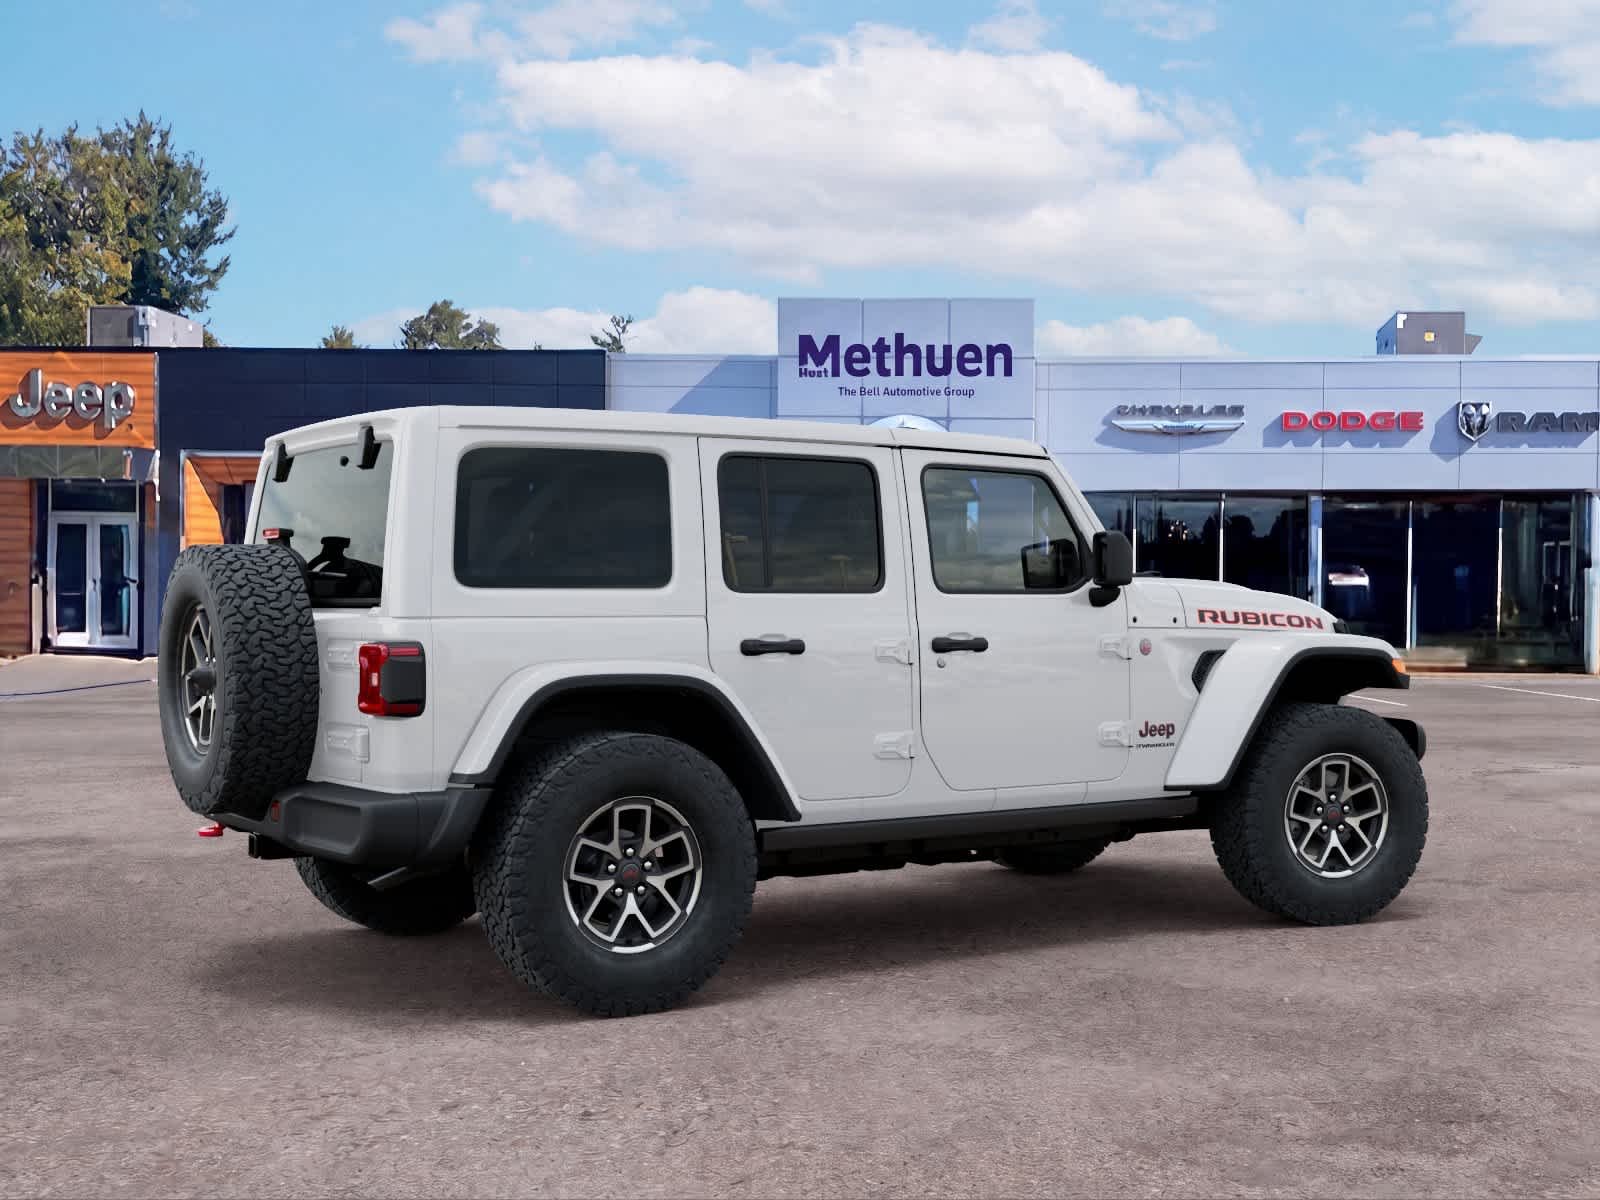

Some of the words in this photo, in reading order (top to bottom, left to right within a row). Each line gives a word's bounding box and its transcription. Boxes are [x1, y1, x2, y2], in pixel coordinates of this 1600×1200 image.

[798, 332, 1013, 378] Methuen
[8, 368, 136, 429] Jeep
[838, 386, 857, 397] The
[859, 386, 880, 397] Bell
[883, 386, 942, 397] Automotive
[943, 386, 975, 399] Group
[1281, 411, 1425, 433] DODGE
[1496, 411, 1600, 433] RAM
[1197, 608, 1324, 630] RUBICON
[1138, 720, 1176, 740] Jeep
